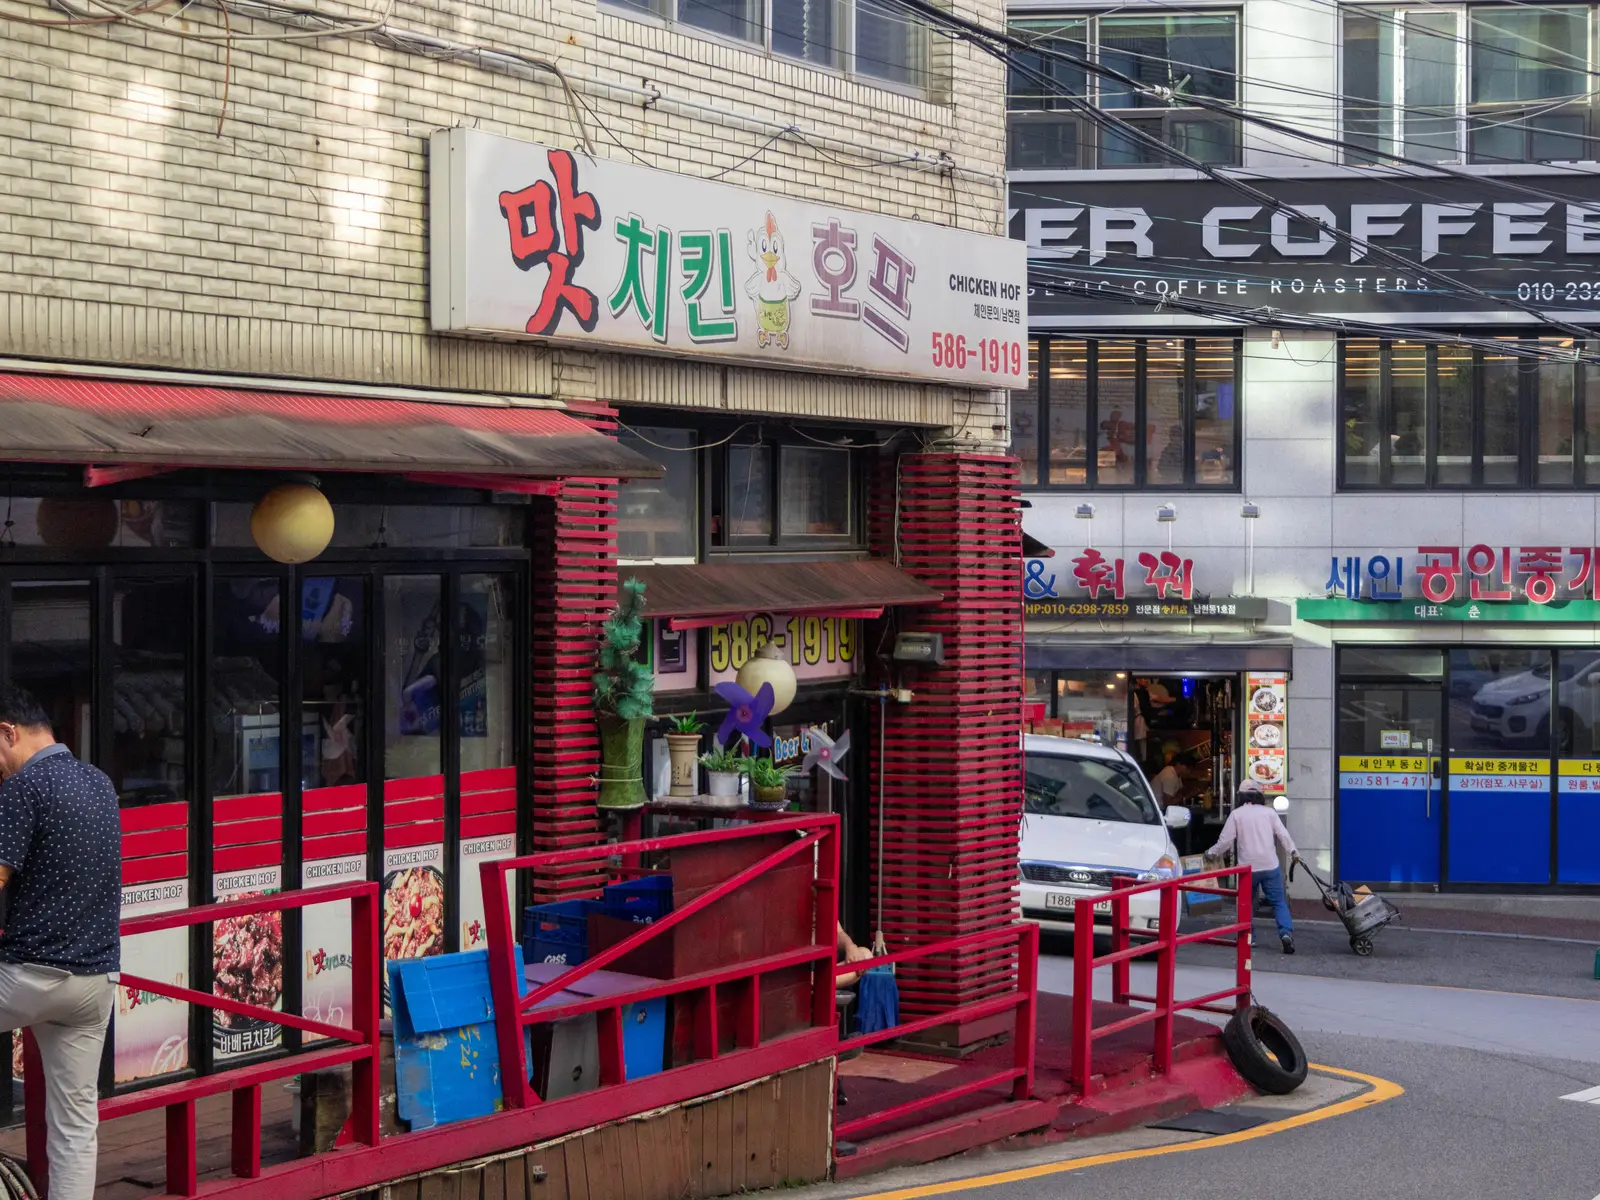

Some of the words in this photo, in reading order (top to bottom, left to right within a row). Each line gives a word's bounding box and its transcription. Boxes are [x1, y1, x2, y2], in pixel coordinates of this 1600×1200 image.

[949, 273, 997, 298] CHICKEN
[1000, 282, 1020, 301] HOF
[1270, 278, 1429, 294] ROASTERS
[932, 331, 1020, 376] 586-1919
[1024, 559, 1058, 599] &
[1326, 555, 1402, 600] 세인
[1025, 603, 1129, 615] HP:010-6298-7859
[774, 735, 799, 764] Beer
[1464, 760, 1494, 772] 확실한
[463, 841, 495, 855] CHICKEN
[496, 838, 511, 850] HOF
[387, 852, 421, 866] CHICKEN
[423, 849, 439, 860] HOF
[305, 864, 343, 878] CHICKEN
[344, 861, 362, 873] HOF
[1072, 871, 1089, 880] KIA
[217, 875, 256, 890] CHICKEN
[258, 871, 277, 884] HOF
[163, 884, 183, 899] HOF
[220, 1026, 275, 1054] 바베큐치킨
